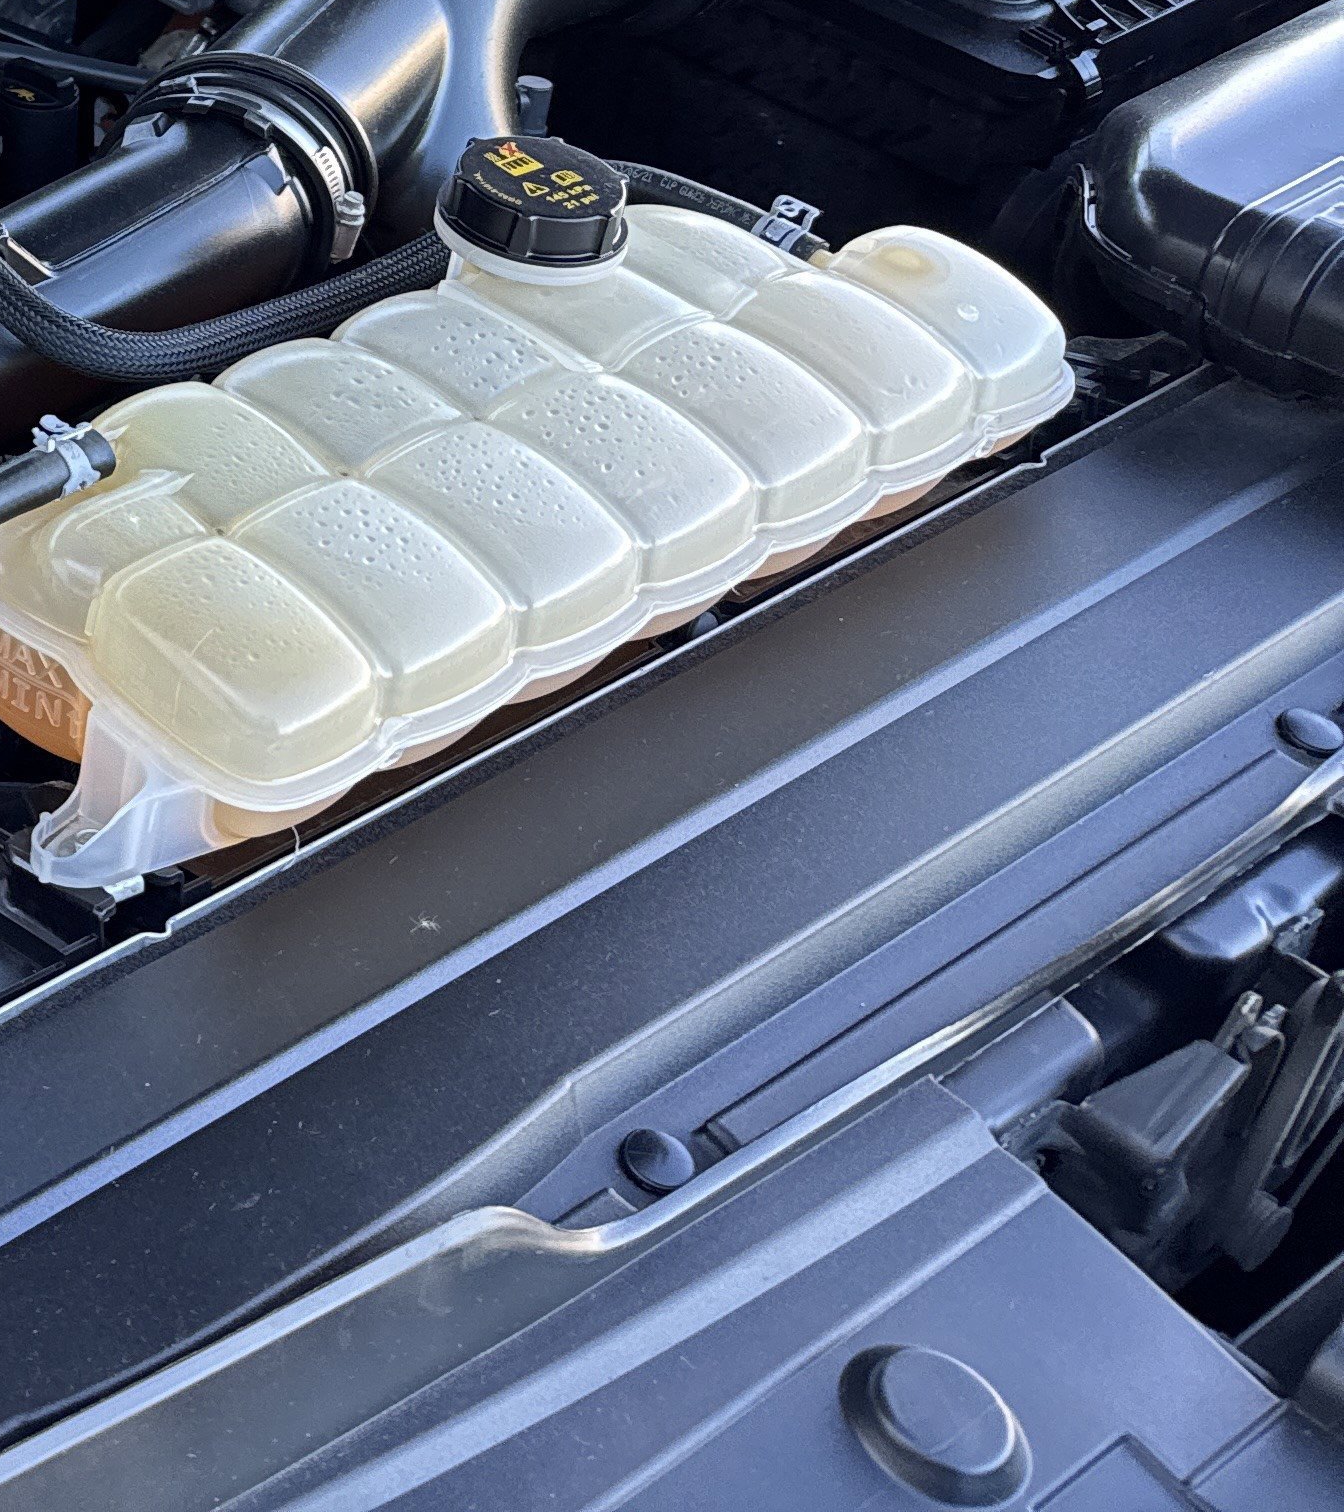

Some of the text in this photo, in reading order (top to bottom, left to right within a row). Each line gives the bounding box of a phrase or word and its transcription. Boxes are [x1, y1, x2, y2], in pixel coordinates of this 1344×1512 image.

[567, 184, 593, 197] kPa
[563, 193, 600, 210] 21 psi
